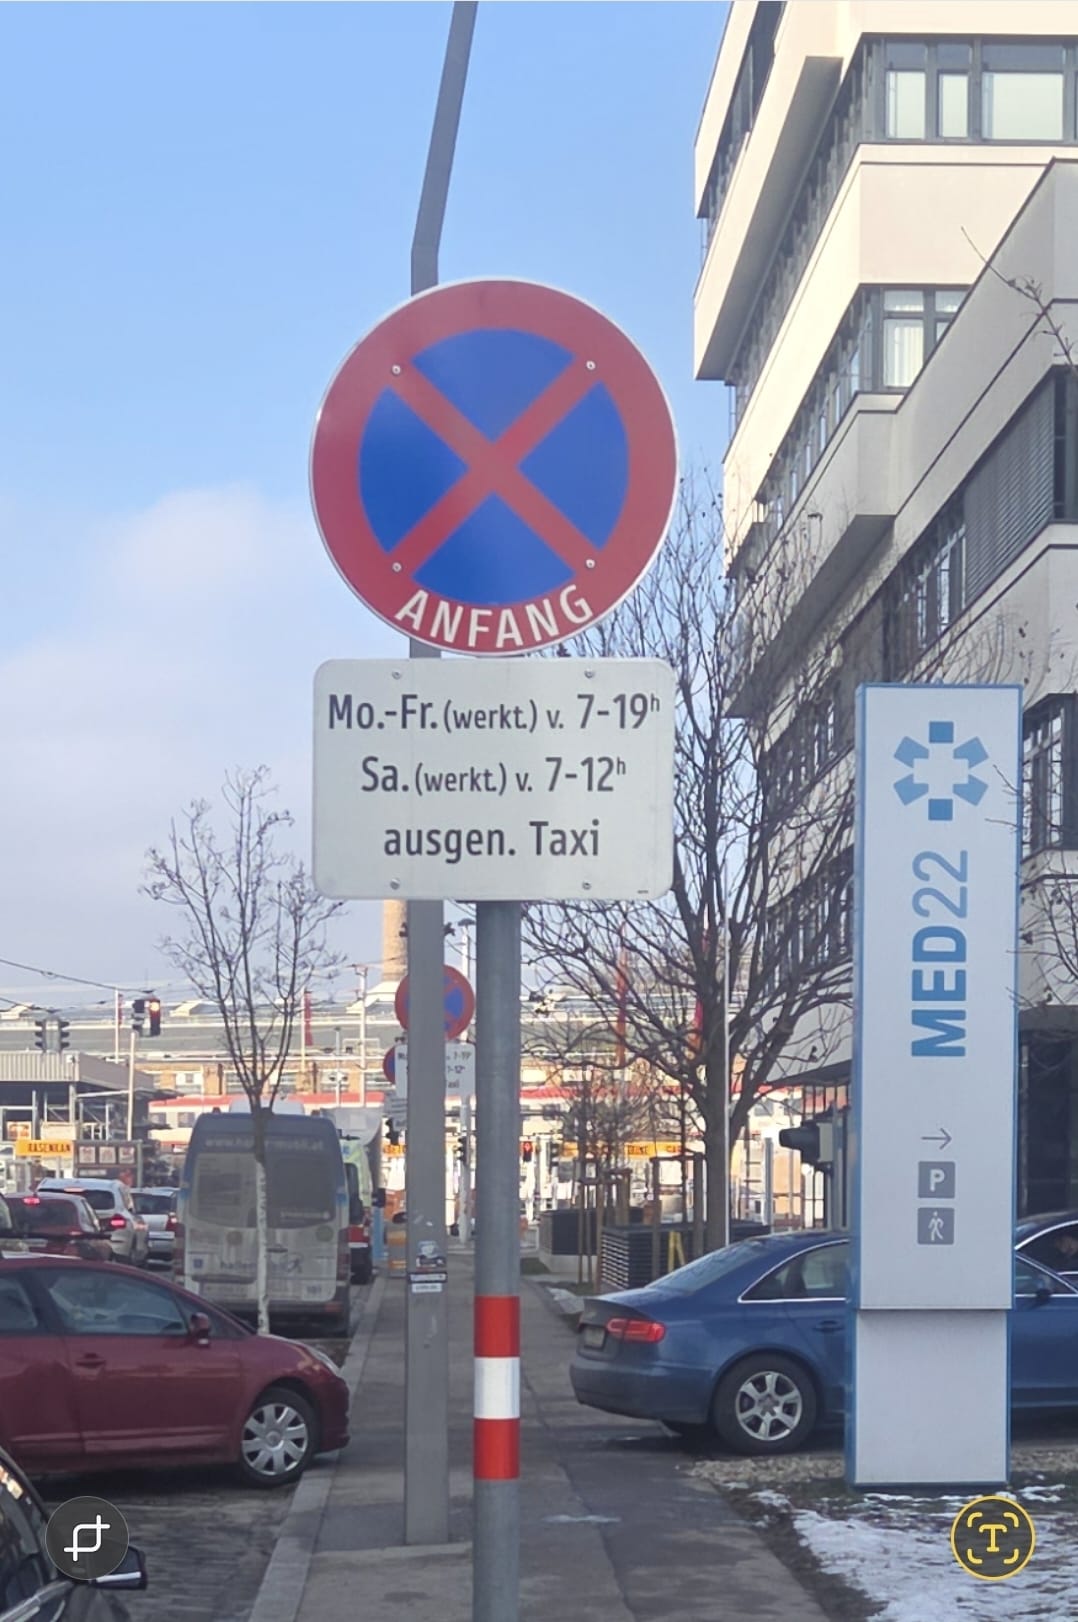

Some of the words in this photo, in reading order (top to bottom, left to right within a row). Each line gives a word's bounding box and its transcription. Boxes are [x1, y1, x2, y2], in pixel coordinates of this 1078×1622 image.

[395, 584, 594, 648] ANFANG
[327, 693, 438, 731] Mo.-Fr.
[443, 699, 540, 734] (werkt.)
[545, 707, 565, 730] v.
[361, 755, 410, 793] Sa.
[414, 762, 508, 796] (werkt.)
[516, 770, 534, 793] v.
[383, 828, 517, 864] ausgen.
[529, 818, 601, 857] Taxi
[911, 849, 969, 1058] MED22
[929, 1167, 946, 1192] P
